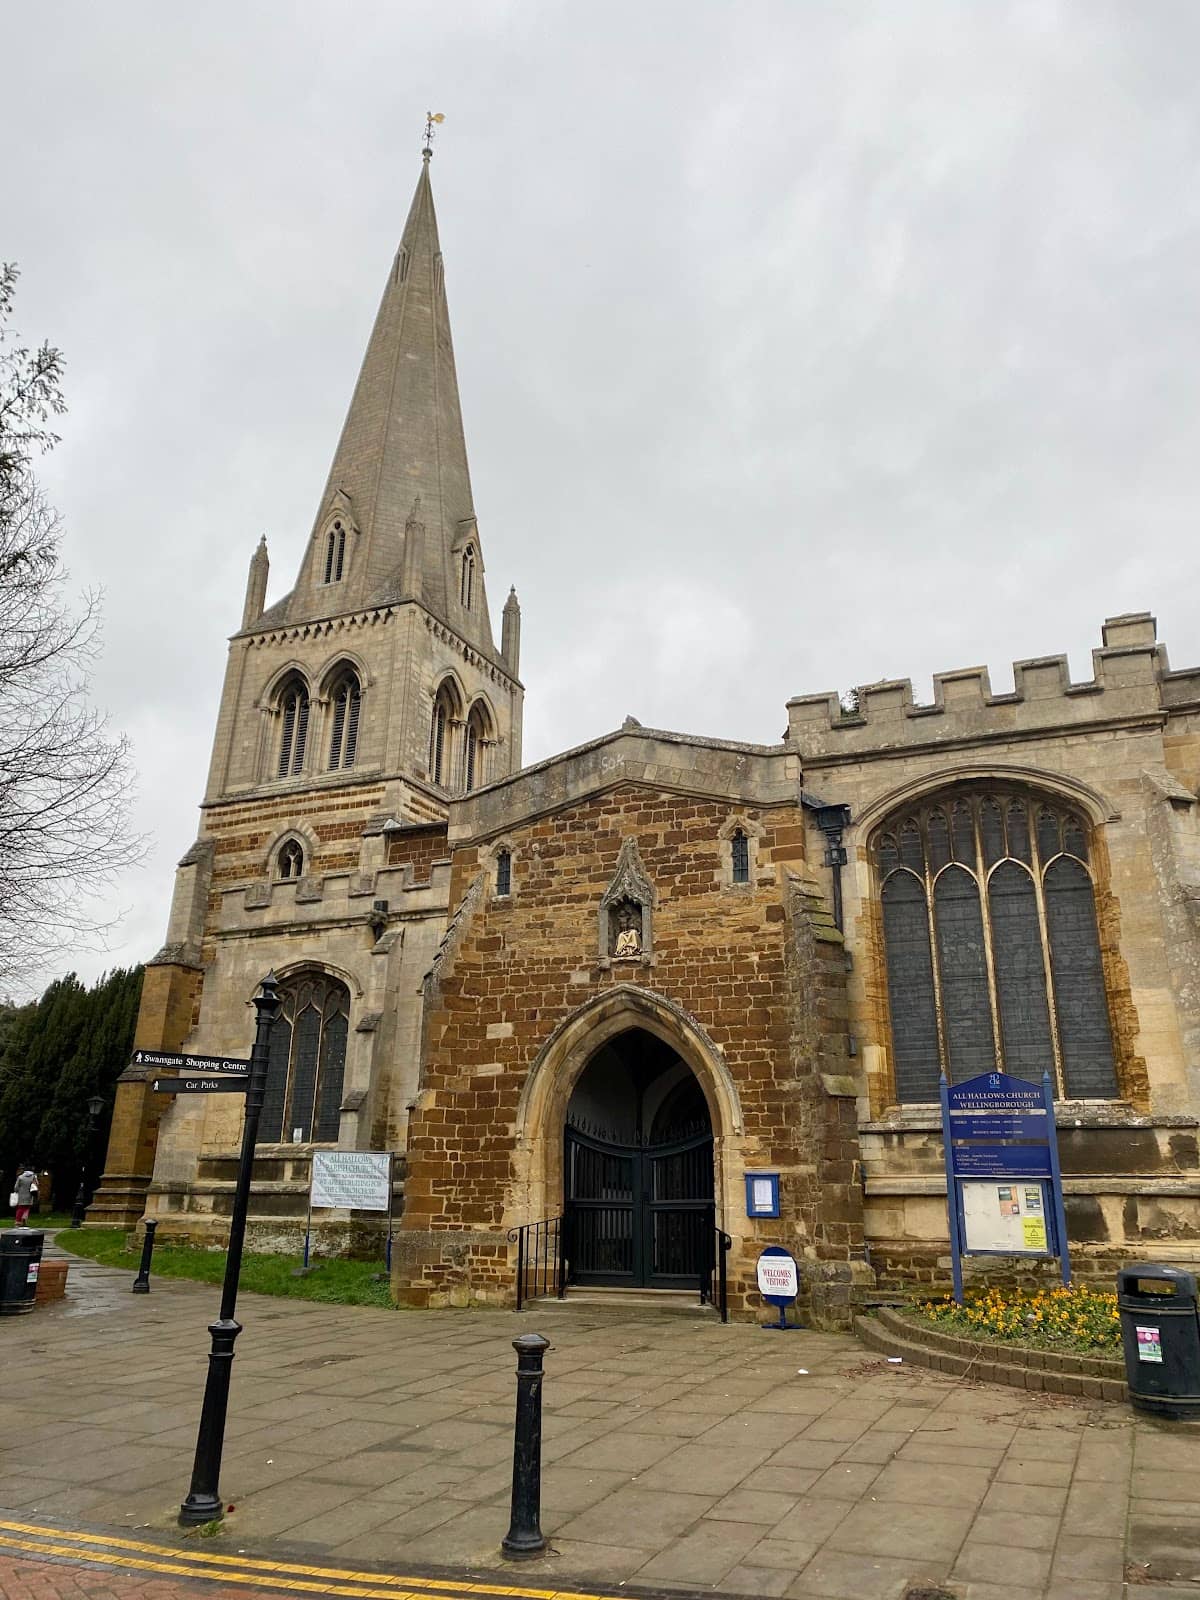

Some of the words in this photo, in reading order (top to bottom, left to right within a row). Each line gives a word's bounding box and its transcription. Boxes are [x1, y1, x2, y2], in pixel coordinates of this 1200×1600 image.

[144, 1054, 183, 1066] Swansgate
[185, 1058, 220, 1070] Shopping
[222, 1061, 247, 1071] Centre
[185, 1081, 198, 1089] Car
[201, 1080, 219, 1089] Parks
[968, 1092, 1005, 1100] HALLOWS
[1006, 1091, 1041, 1099] CHURCH
[959, 1101, 1035, 1109] WELLINGBOROUGH
[762, 1268, 792, 1278] WELCOMES
[765, 1277, 790, 1287] VISITORS
